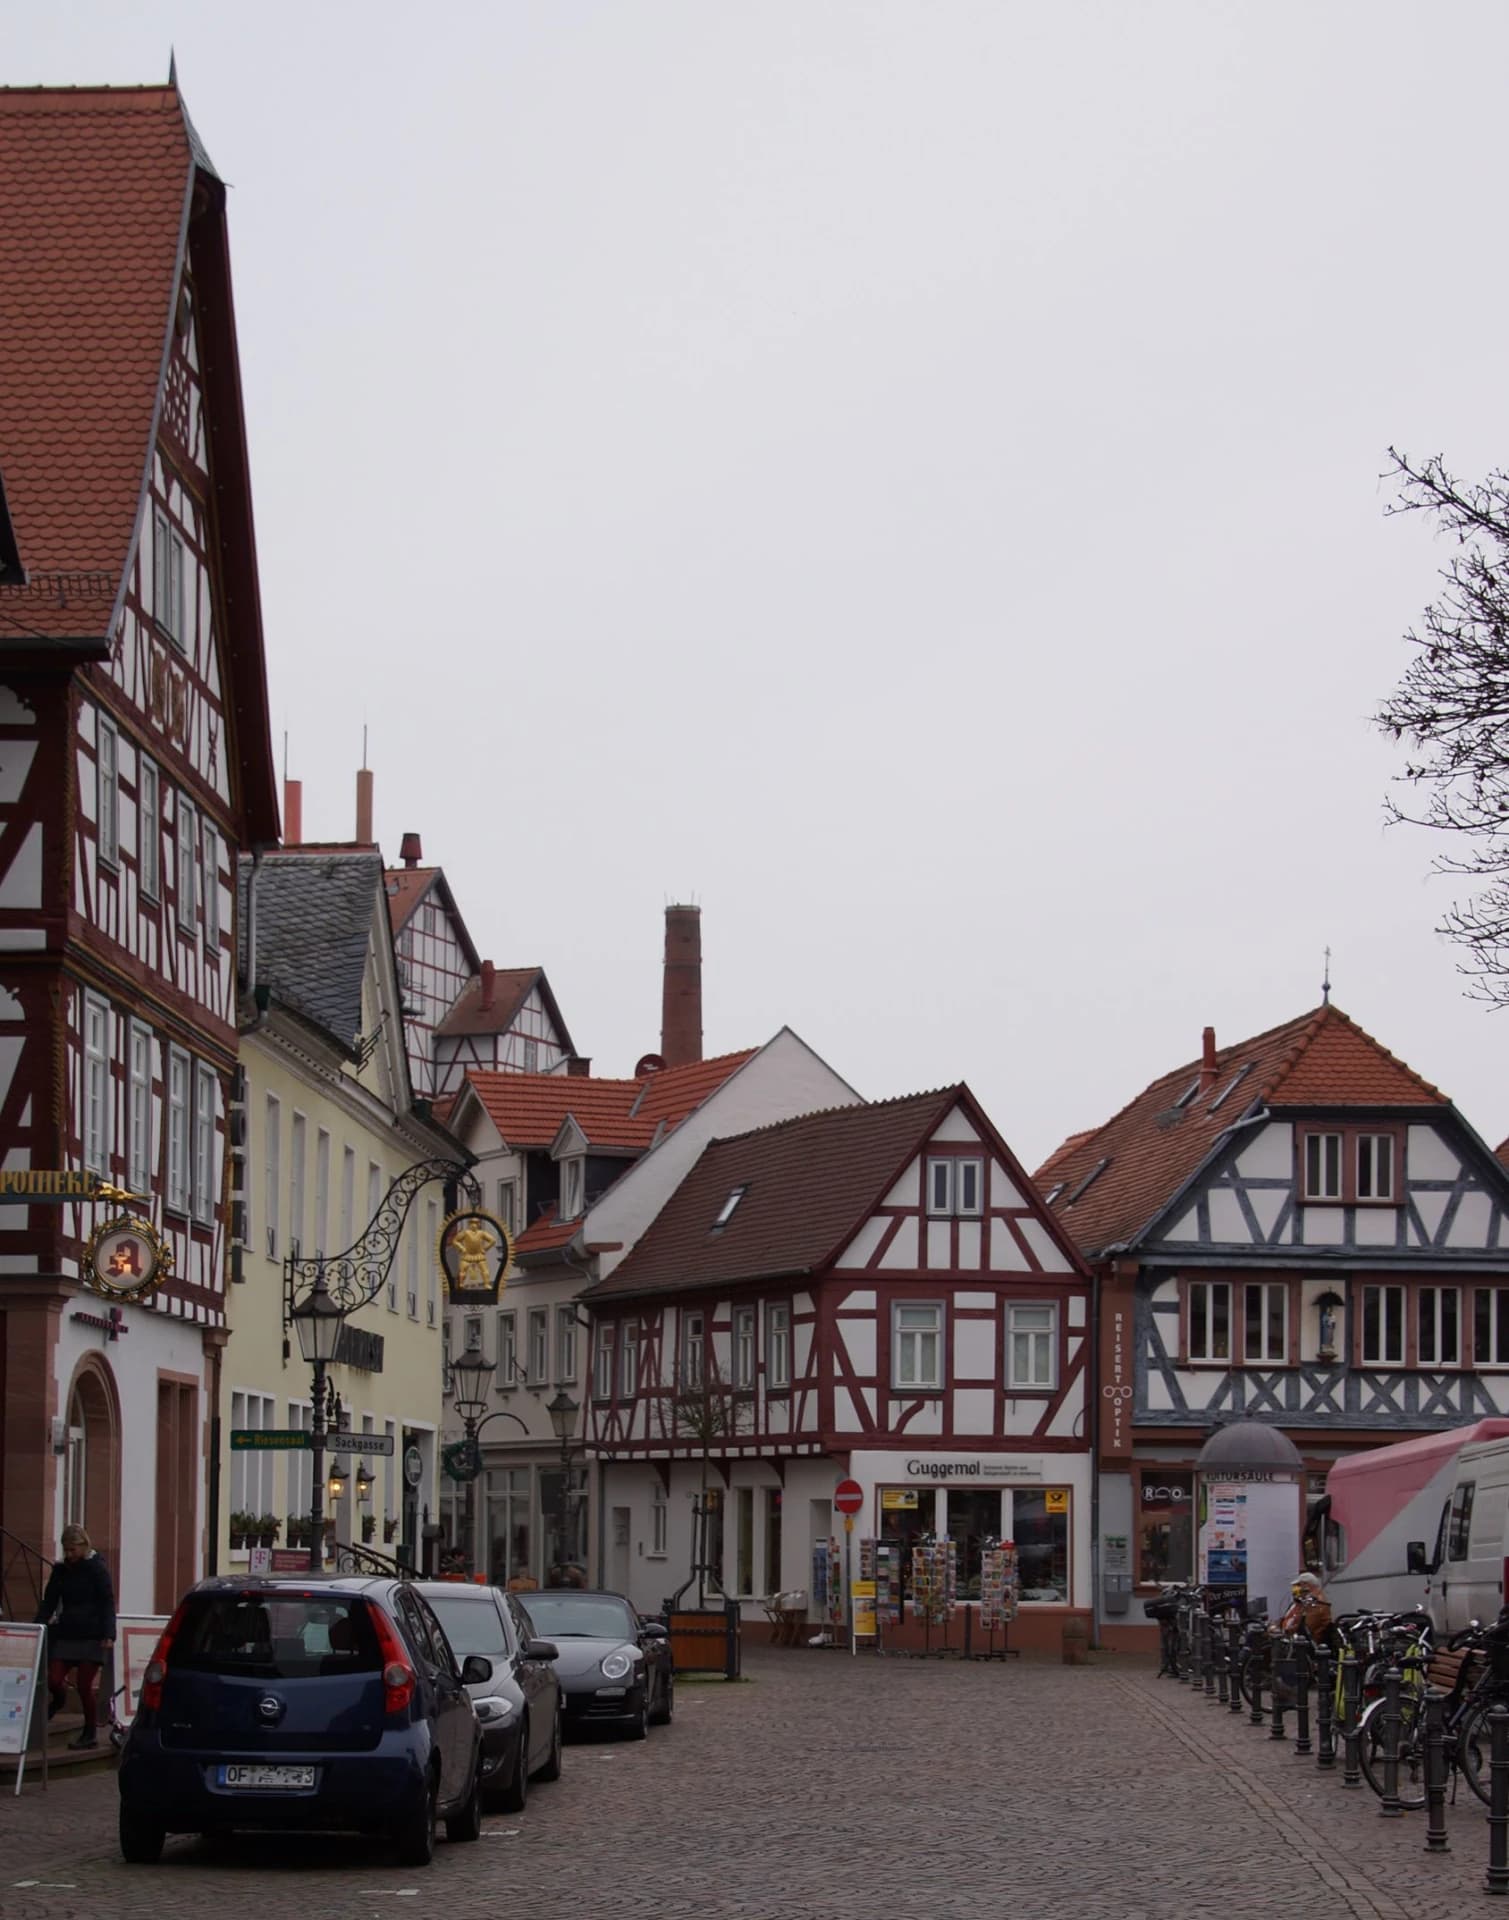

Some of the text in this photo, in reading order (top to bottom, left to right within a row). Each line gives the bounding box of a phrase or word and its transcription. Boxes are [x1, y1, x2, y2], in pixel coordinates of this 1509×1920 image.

[1114, 1312, 1123, 1384] REISERT
[1113, 1397, 1122, 1448] OPTIK
[335, 1436, 385, 1451] Sackgasse
[907, 1459, 980, 1479] Guggemol
